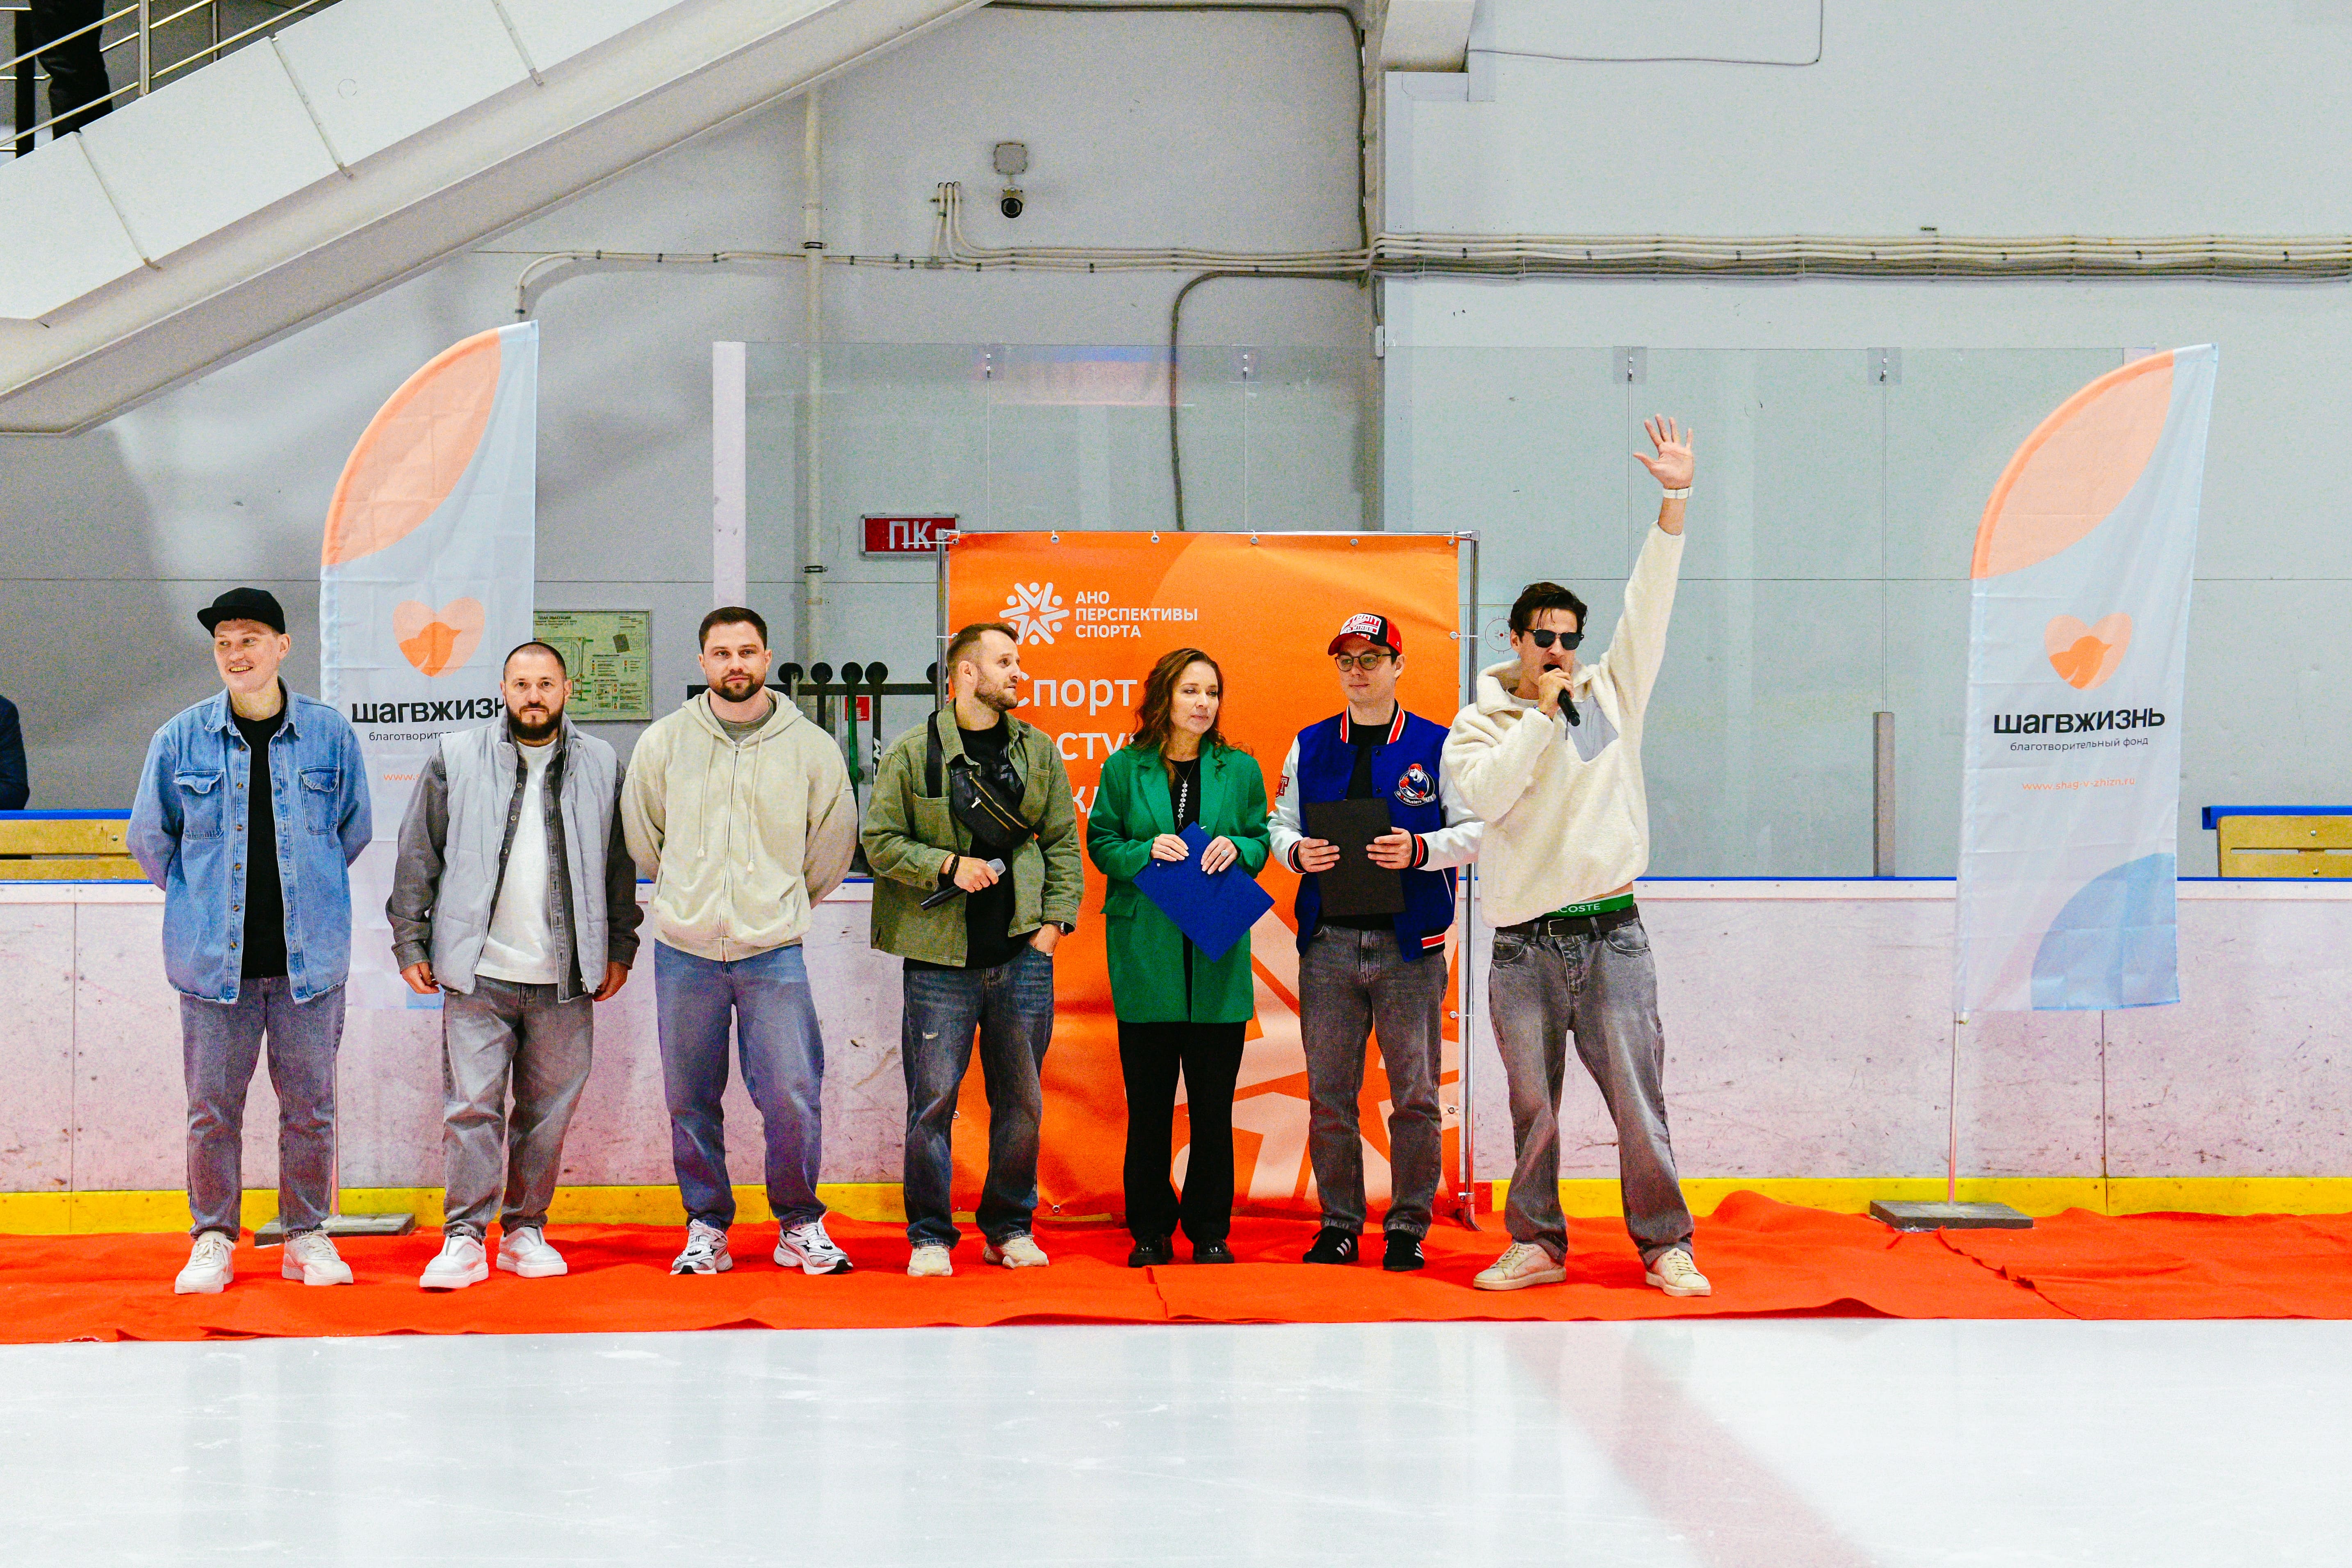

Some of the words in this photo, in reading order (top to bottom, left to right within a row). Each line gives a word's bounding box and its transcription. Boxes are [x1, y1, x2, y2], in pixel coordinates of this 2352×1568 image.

[889, 521, 932, 549] ПК
[1075, 591, 1110, 604] АНО
[1076, 608, 1197, 621] ПЕРСПЕКТИВЫ
[1076, 625, 1142, 638] СПОРТА
[1994, 708, 2165, 734] шагвжизнь
[369, 731, 454, 741] благотворит
[2010, 738, 2120, 752] благотворительный
[2123, 737, 2148, 746] фонд
[2022, 777, 2135, 790] www.shag-v-zhizn.ru
[1557, 903, 1600, 913] COSTE
